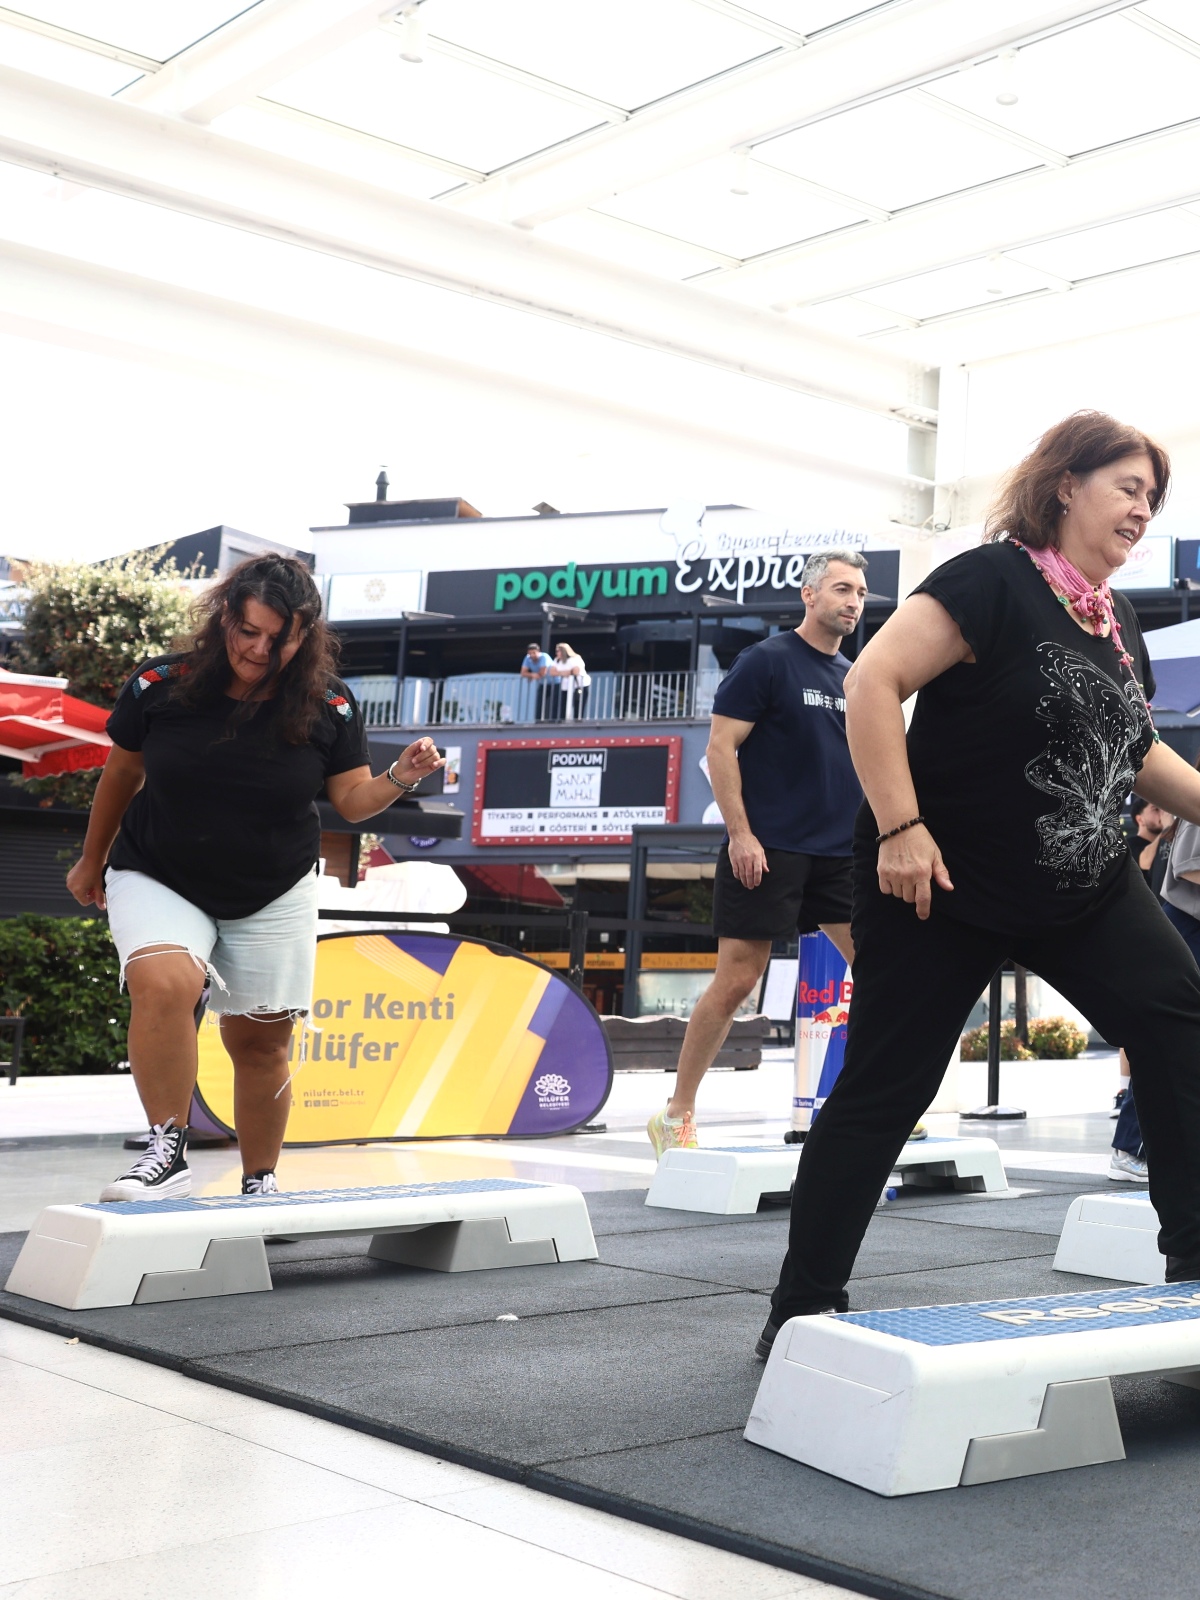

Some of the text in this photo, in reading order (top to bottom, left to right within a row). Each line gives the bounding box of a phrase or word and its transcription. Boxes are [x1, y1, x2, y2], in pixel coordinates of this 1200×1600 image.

[494, 539, 804, 612] podyum Expre
[552, 753, 603, 766] PODYUM
[537, 811, 598, 820] PERFORMANS
[613, 809, 664, 819] ATÖLYELER
[602, 823, 633, 832] SÖYLE
[799, 980, 835, 1004] Red
[312, 993, 456, 1020] or Kenti
[303, 1088, 365, 1097] nilufer.bel.tr
